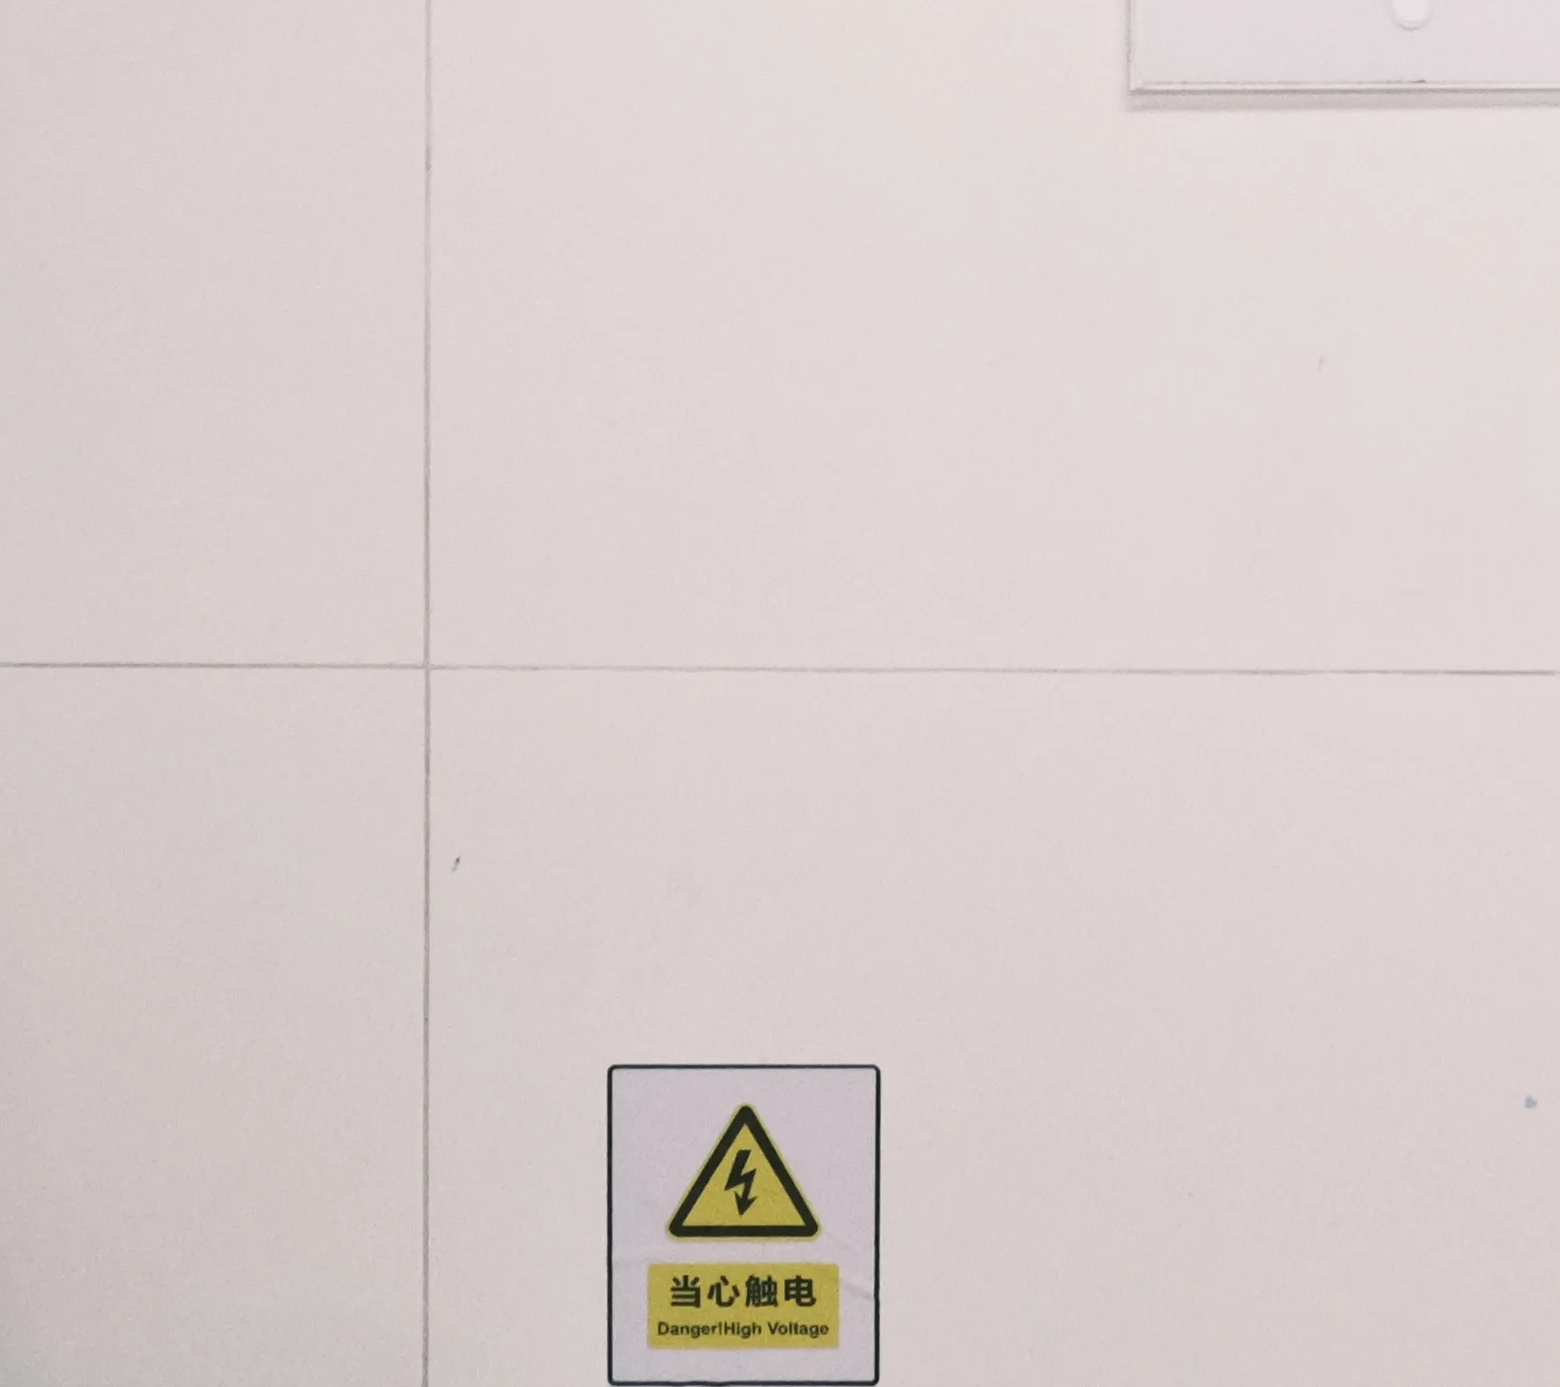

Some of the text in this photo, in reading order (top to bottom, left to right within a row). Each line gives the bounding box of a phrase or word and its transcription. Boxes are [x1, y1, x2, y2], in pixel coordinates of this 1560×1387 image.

[670, 1274, 817, 1309] 当心触电
[767, 1321, 829, 1339] Voltage
